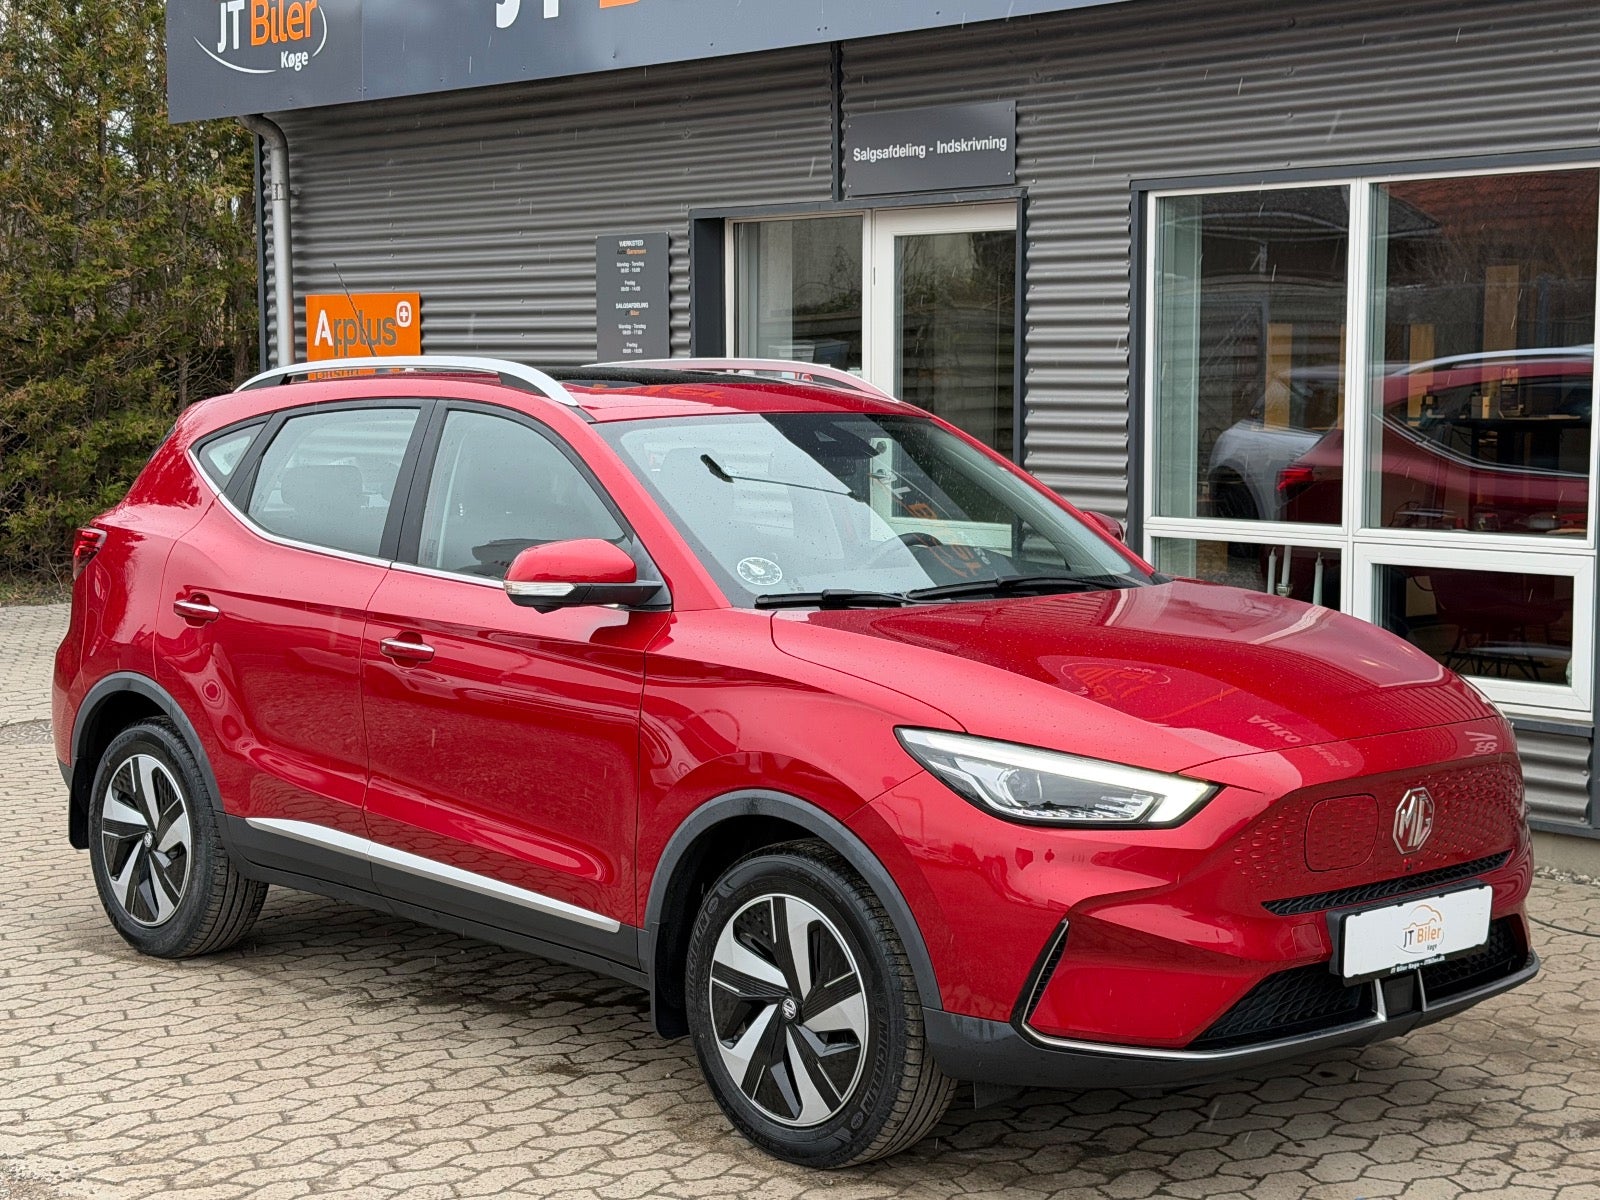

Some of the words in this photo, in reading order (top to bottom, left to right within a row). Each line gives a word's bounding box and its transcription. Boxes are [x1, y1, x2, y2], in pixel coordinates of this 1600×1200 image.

[217, 0, 245, 53] JT
[250, 0, 318, 46] Biler
[280, 51, 309, 72] Køge
[853, 143, 926, 163] Salgsafdeling
[936, 135, 1007, 154] Indskrivning
[1397, 793, 1434, 848] MG
[1403, 930, 1415, 948] JT
[1417, 926, 1442, 943] Biler
[860, 1020, 888, 1115] MICHELIN
